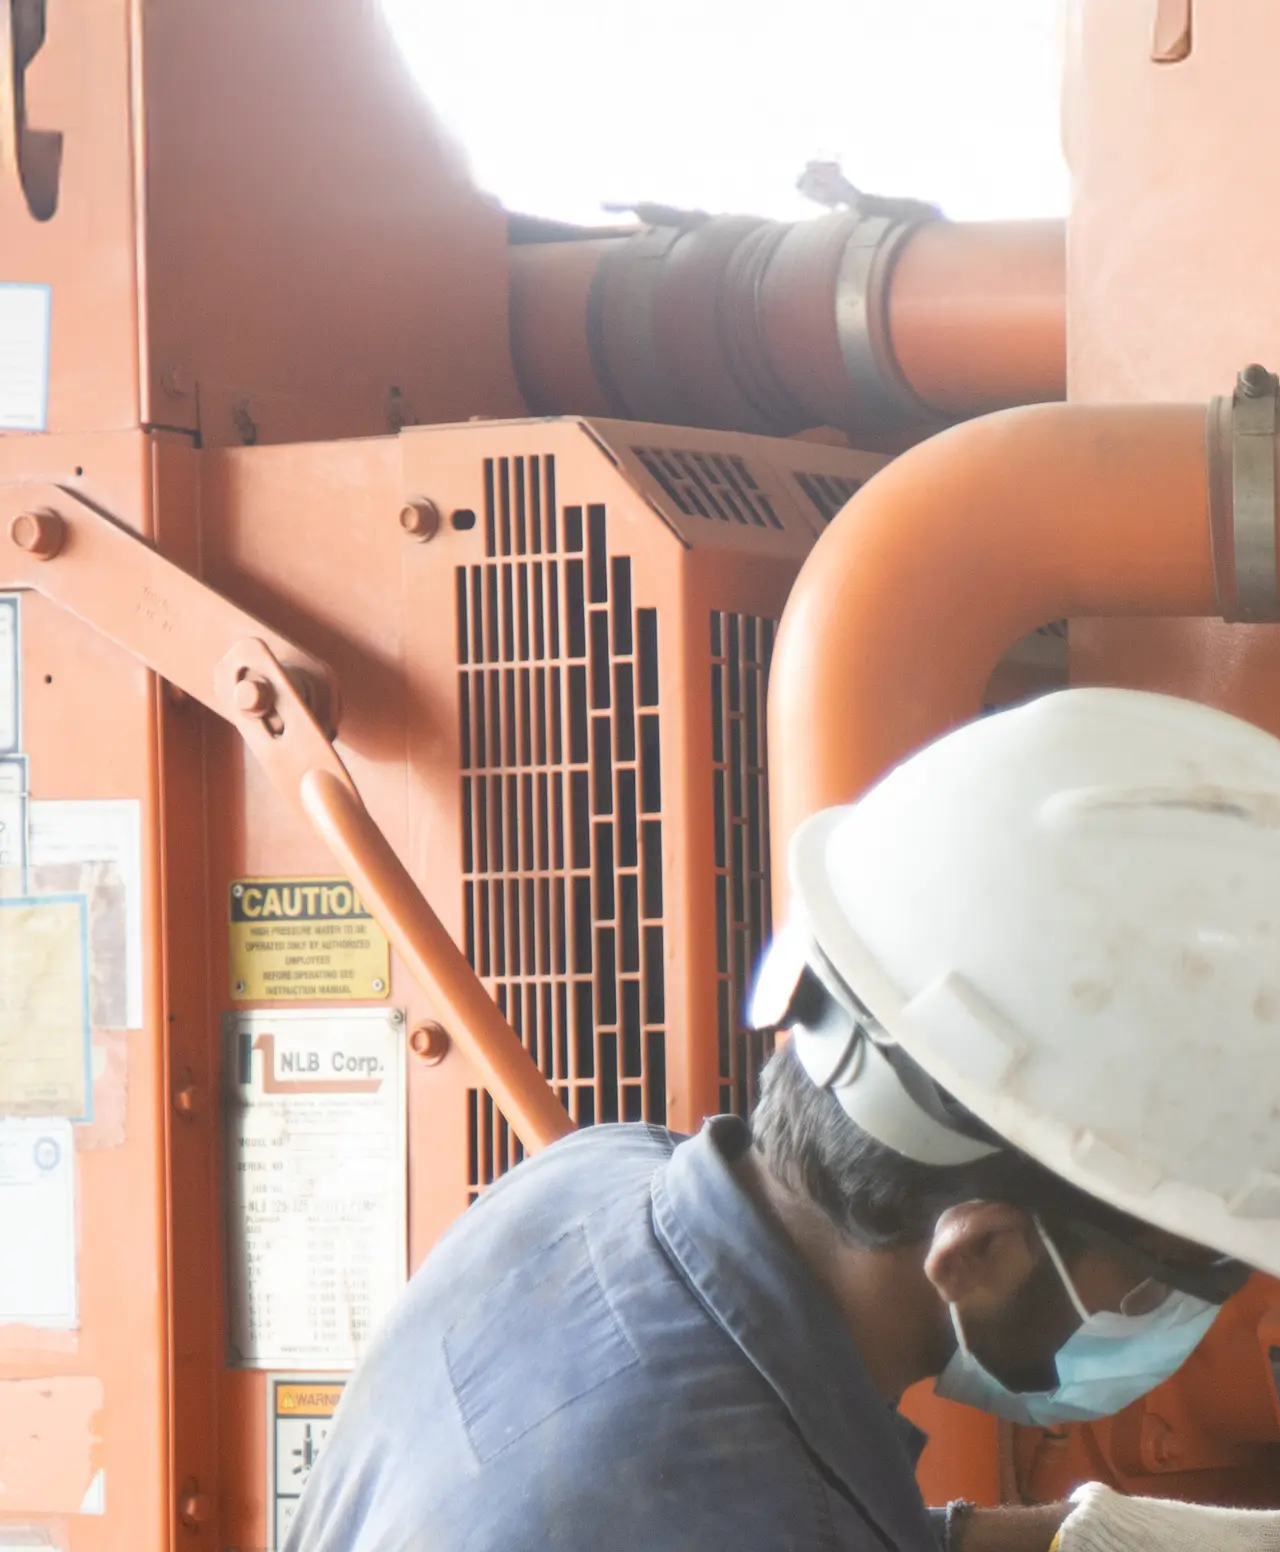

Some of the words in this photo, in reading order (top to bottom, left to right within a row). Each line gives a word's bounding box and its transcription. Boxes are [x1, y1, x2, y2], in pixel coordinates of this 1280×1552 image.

[281, 1052, 320, 1072] NLB
[332, 1051, 384, 1077] Corp.
[296, 1393, 341, 1406] WARNI
